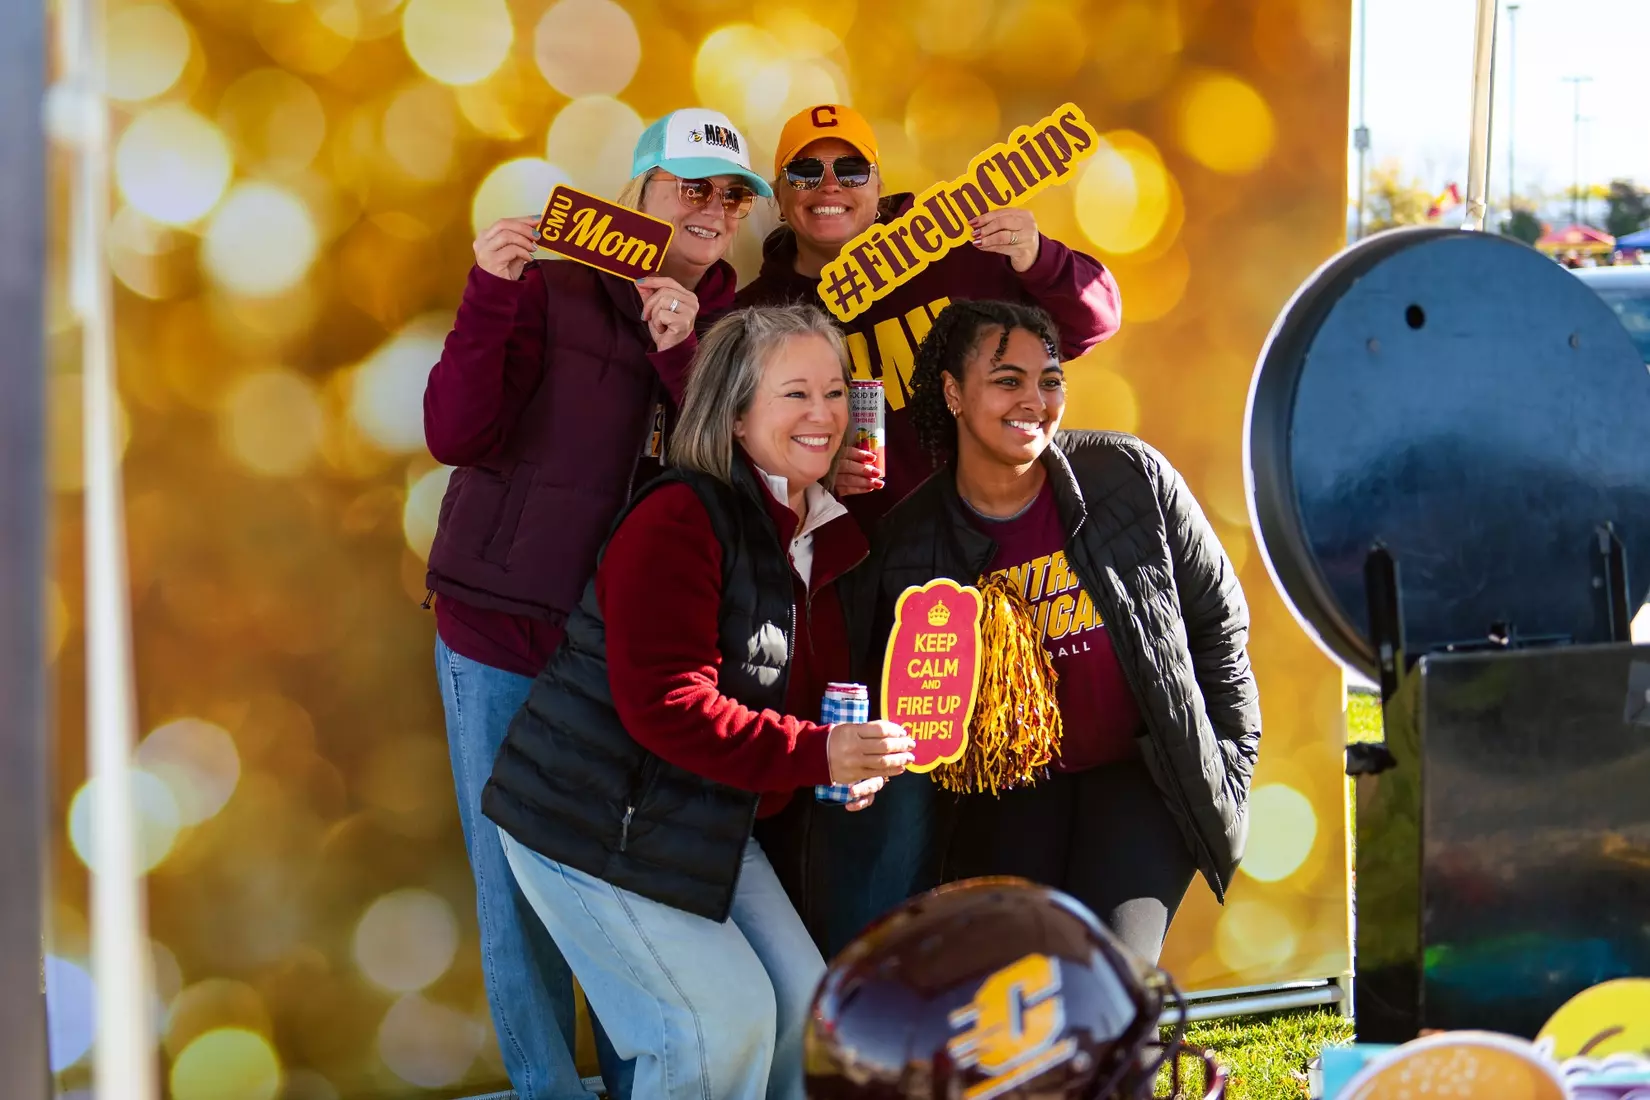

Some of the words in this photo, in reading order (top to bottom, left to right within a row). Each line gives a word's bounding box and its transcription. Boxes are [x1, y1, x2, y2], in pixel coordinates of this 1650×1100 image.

[811, 105, 838, 128] C
[542, 194, 573, 242] CMU
[826, 110, 1092, 314] #FireUpChips
[564, 207, 658, 271] Mom
[914, 633, 958, 653] KEEP
[907, 658, 960, 678] CALM
[921, 680, 941, 690] AND
[896, 696, 934, 716] FIRE
[937, 695, 961, 715] UP
[901, 720, 954, 740] CHIPS!
